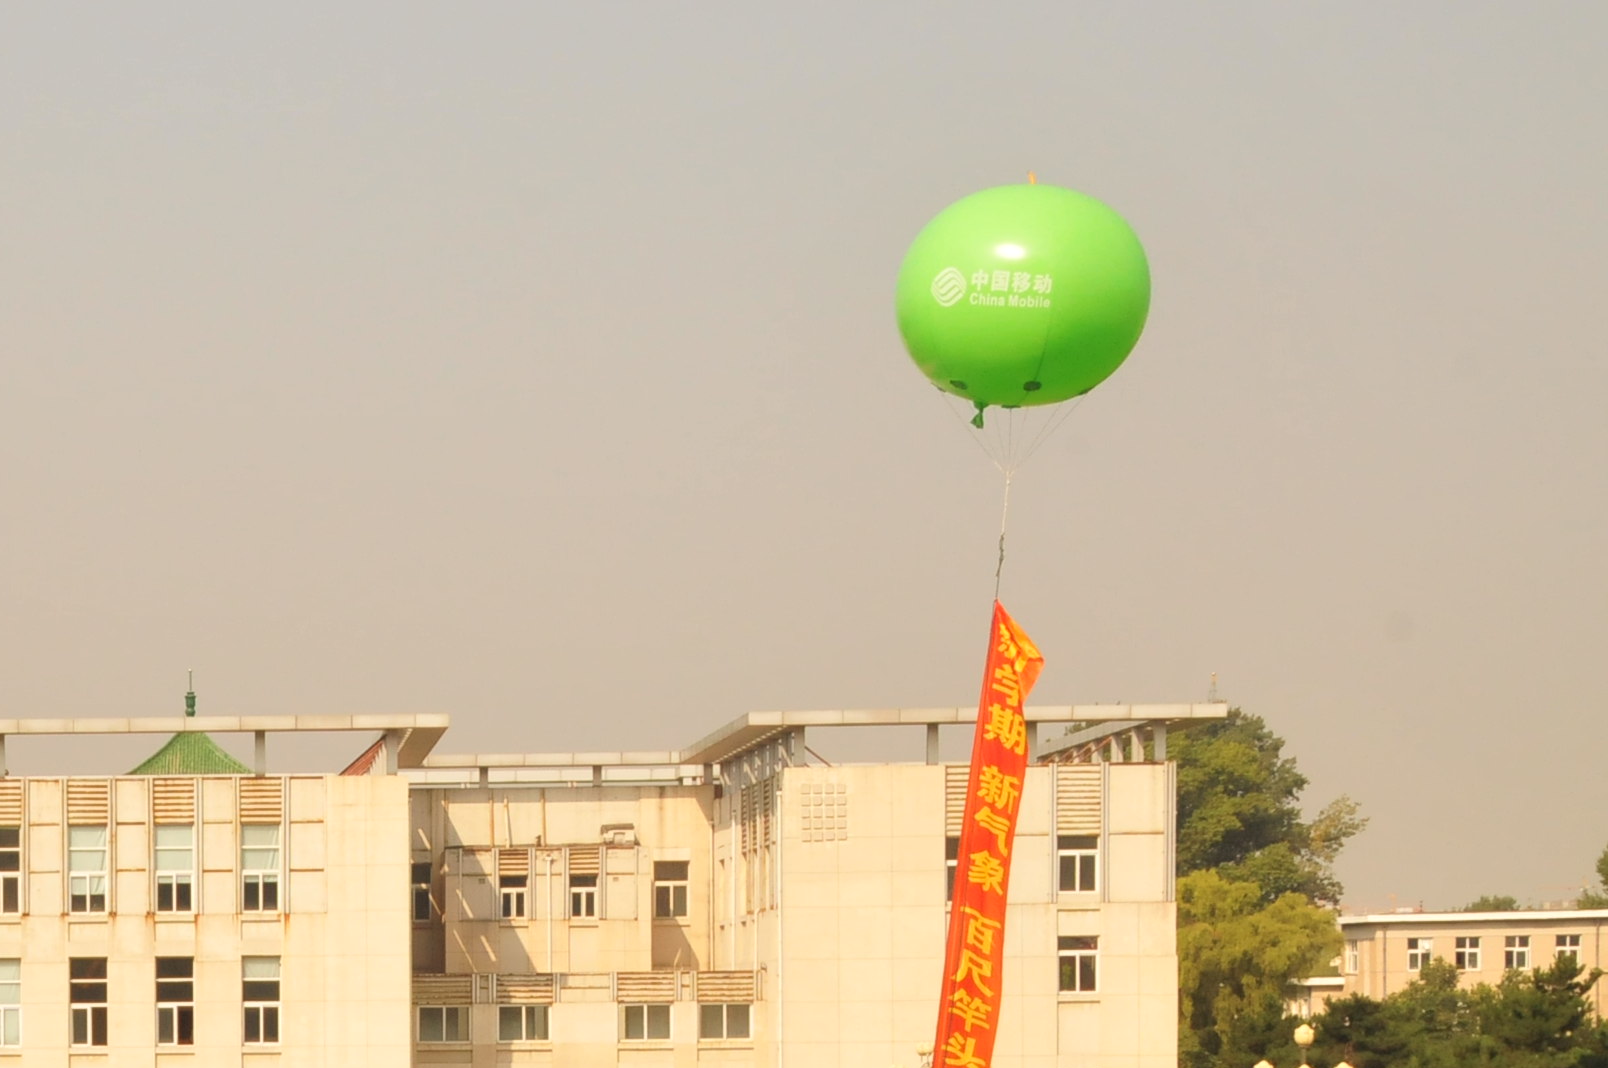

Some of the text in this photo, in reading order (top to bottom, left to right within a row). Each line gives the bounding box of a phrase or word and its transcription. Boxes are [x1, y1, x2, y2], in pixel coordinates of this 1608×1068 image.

[971, 269, 1053, 294] 中国移动
[969, 292, 1052, 308] China Mobile
